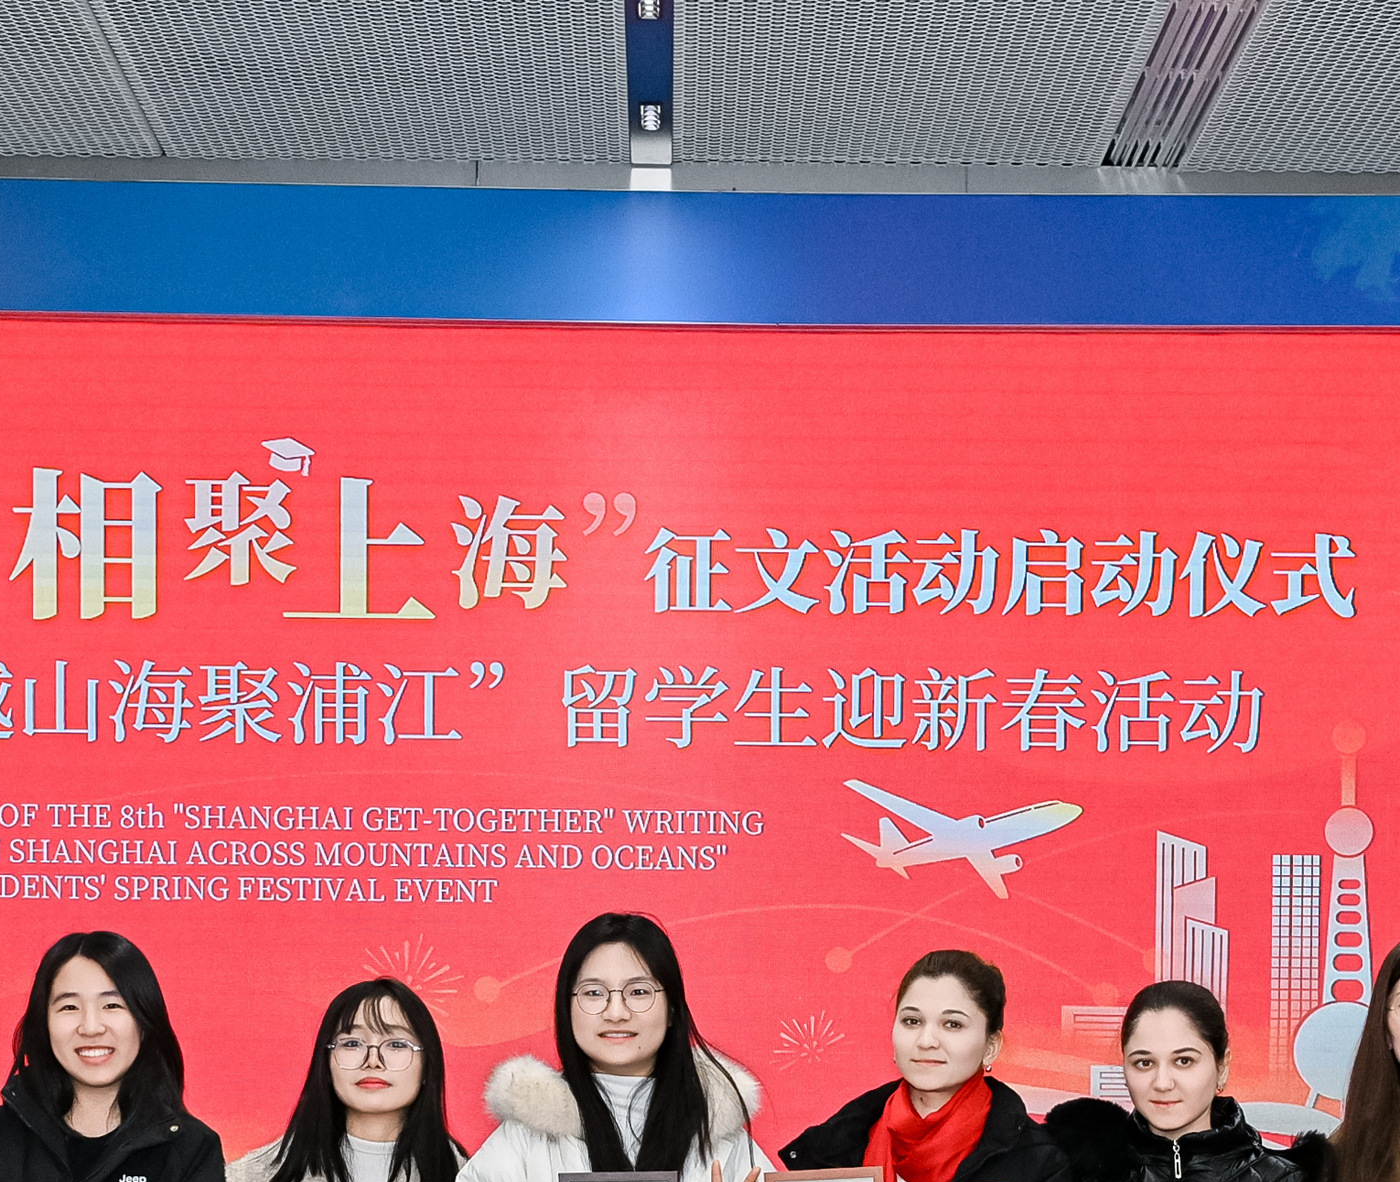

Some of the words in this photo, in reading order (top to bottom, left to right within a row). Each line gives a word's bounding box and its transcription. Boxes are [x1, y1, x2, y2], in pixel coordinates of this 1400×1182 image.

[47, 804, 112, 829] THE
[120, 803, 164, 829] 8th
[174, 804, 353, 831] "SHANGHAI
[363, 807, 614, 833] GET-TOGETHER"
[624, 810, 764, 835] WRITING
[9, 839, 177, 865] SHANGHAI
[187, 841, 305, 867] ACROSS
[314, 842, 507, 869] MOUNTAINS
[515, 844, 583, 869] AND
[591, 845, 729, 871] OCEANS"
[114, 875, 230, 901] SPRING
[238, 877, 385, 902] FESTIVAL
[394, 878, 499, 903] EVENT
